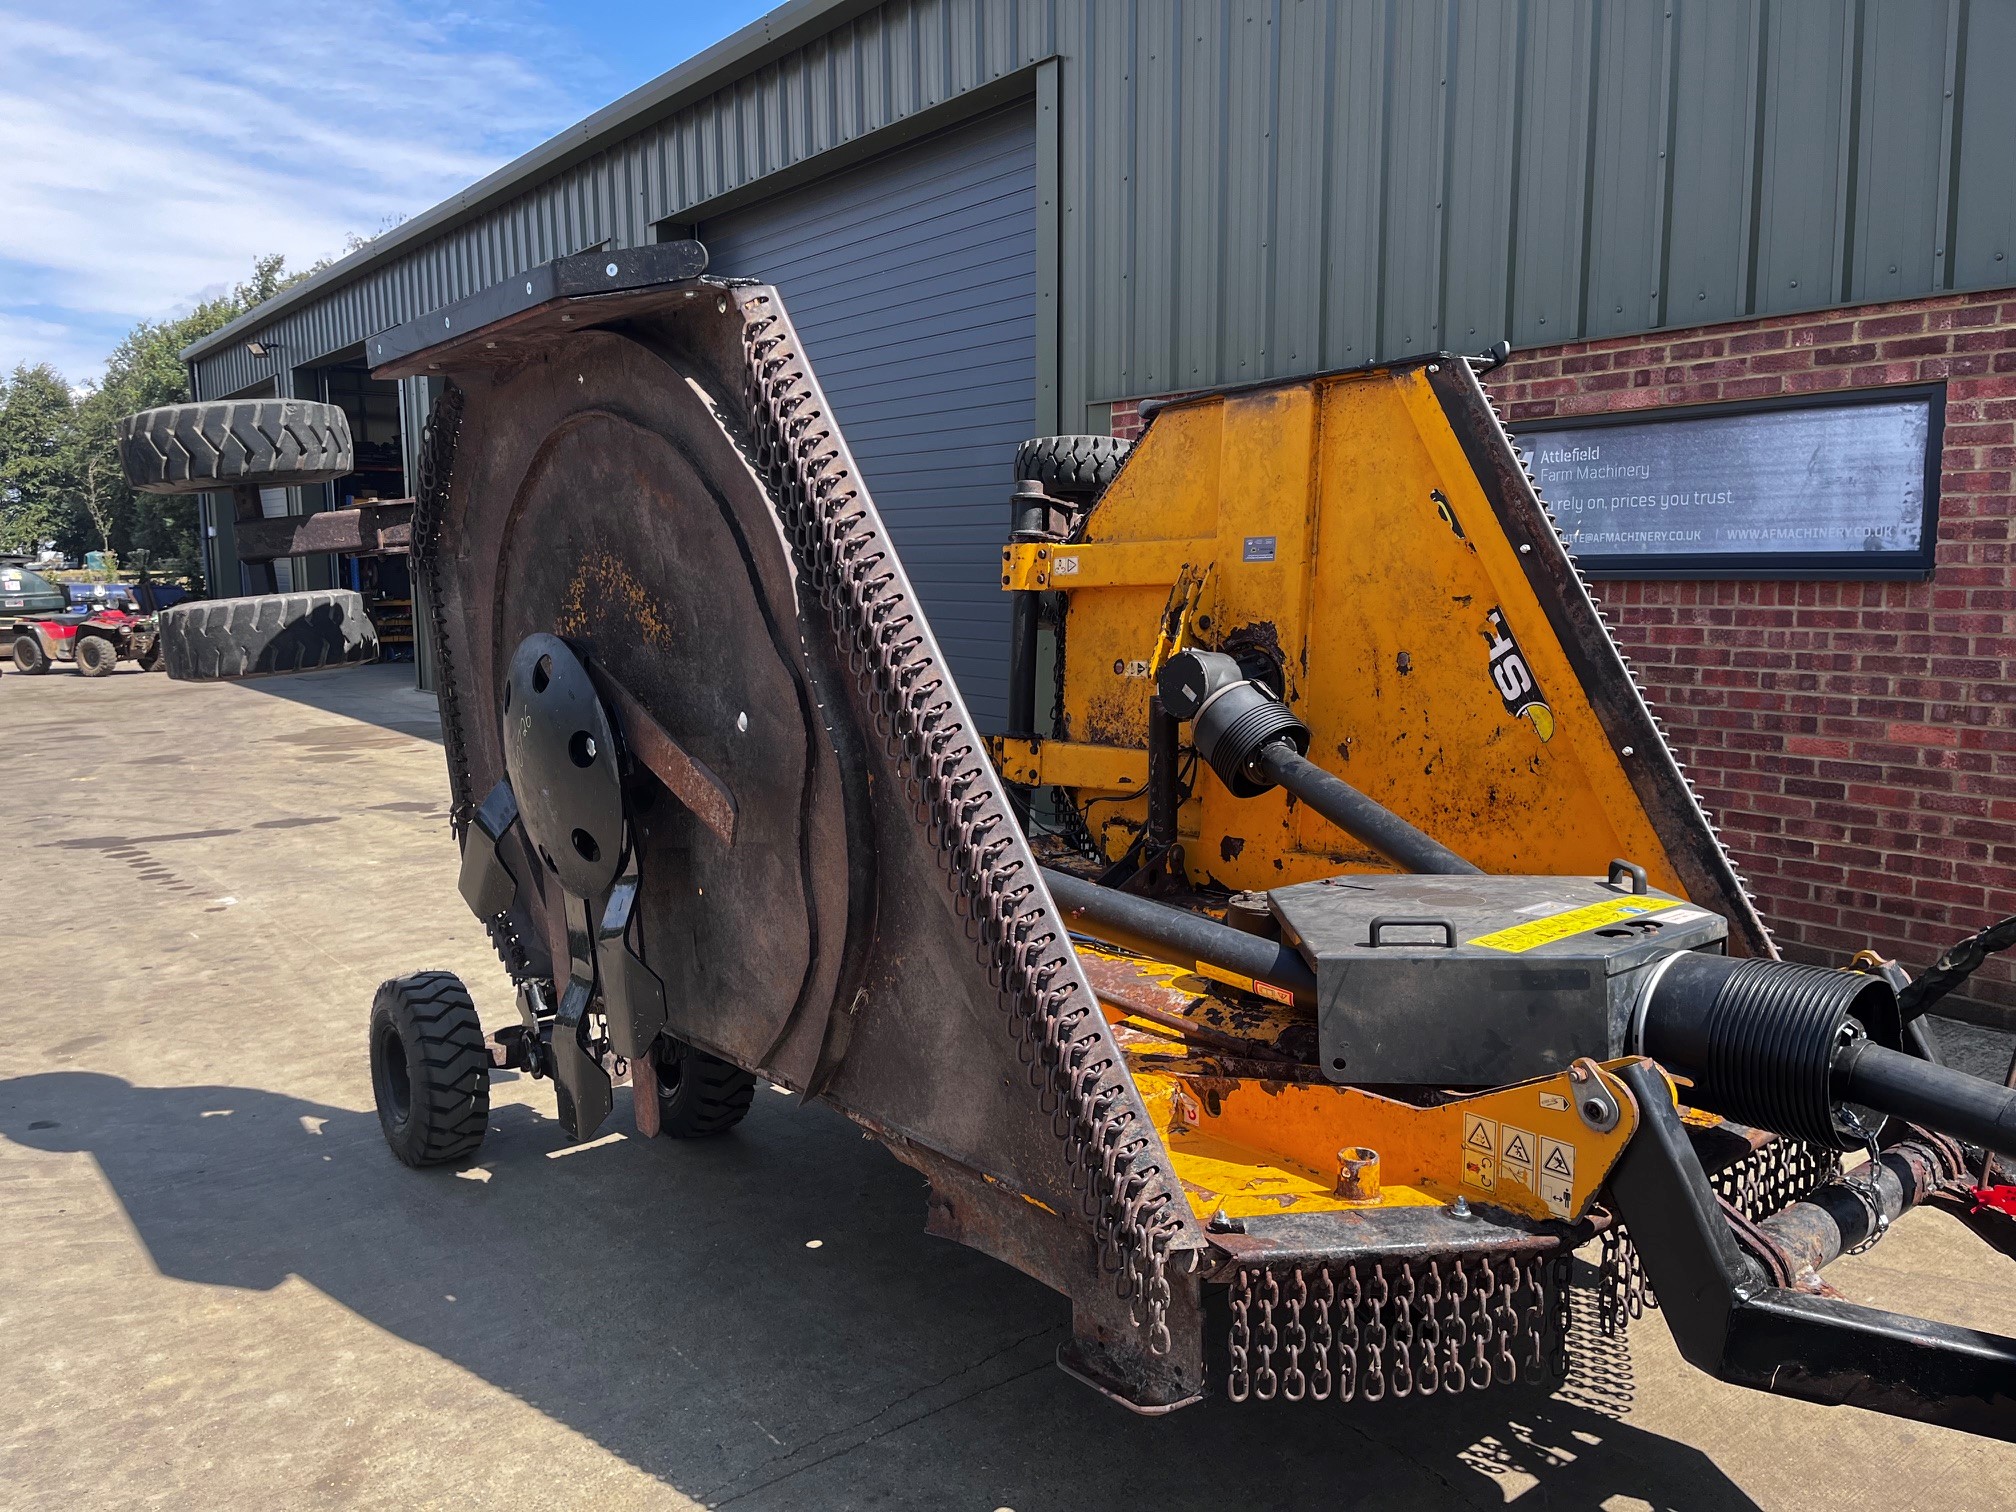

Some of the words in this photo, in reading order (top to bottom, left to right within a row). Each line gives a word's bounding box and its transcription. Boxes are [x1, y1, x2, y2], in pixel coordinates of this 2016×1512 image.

[1540, 446, 1600, 464] Attlefield
[1540, 468, 1573, 482] Farm
[1576, 463, 1650, 480] Machinery
[1557, 496, 1584, 514] rely
[1611, 493, 1656, 512] prices
[1660, 494, 1690, 511] you
[1560, 530, 1702, 544] HITE@AFMACHINERY.CO.UK
[1727, 526, 1893, 541] WWW.AFMACHINERY.CO.UK
